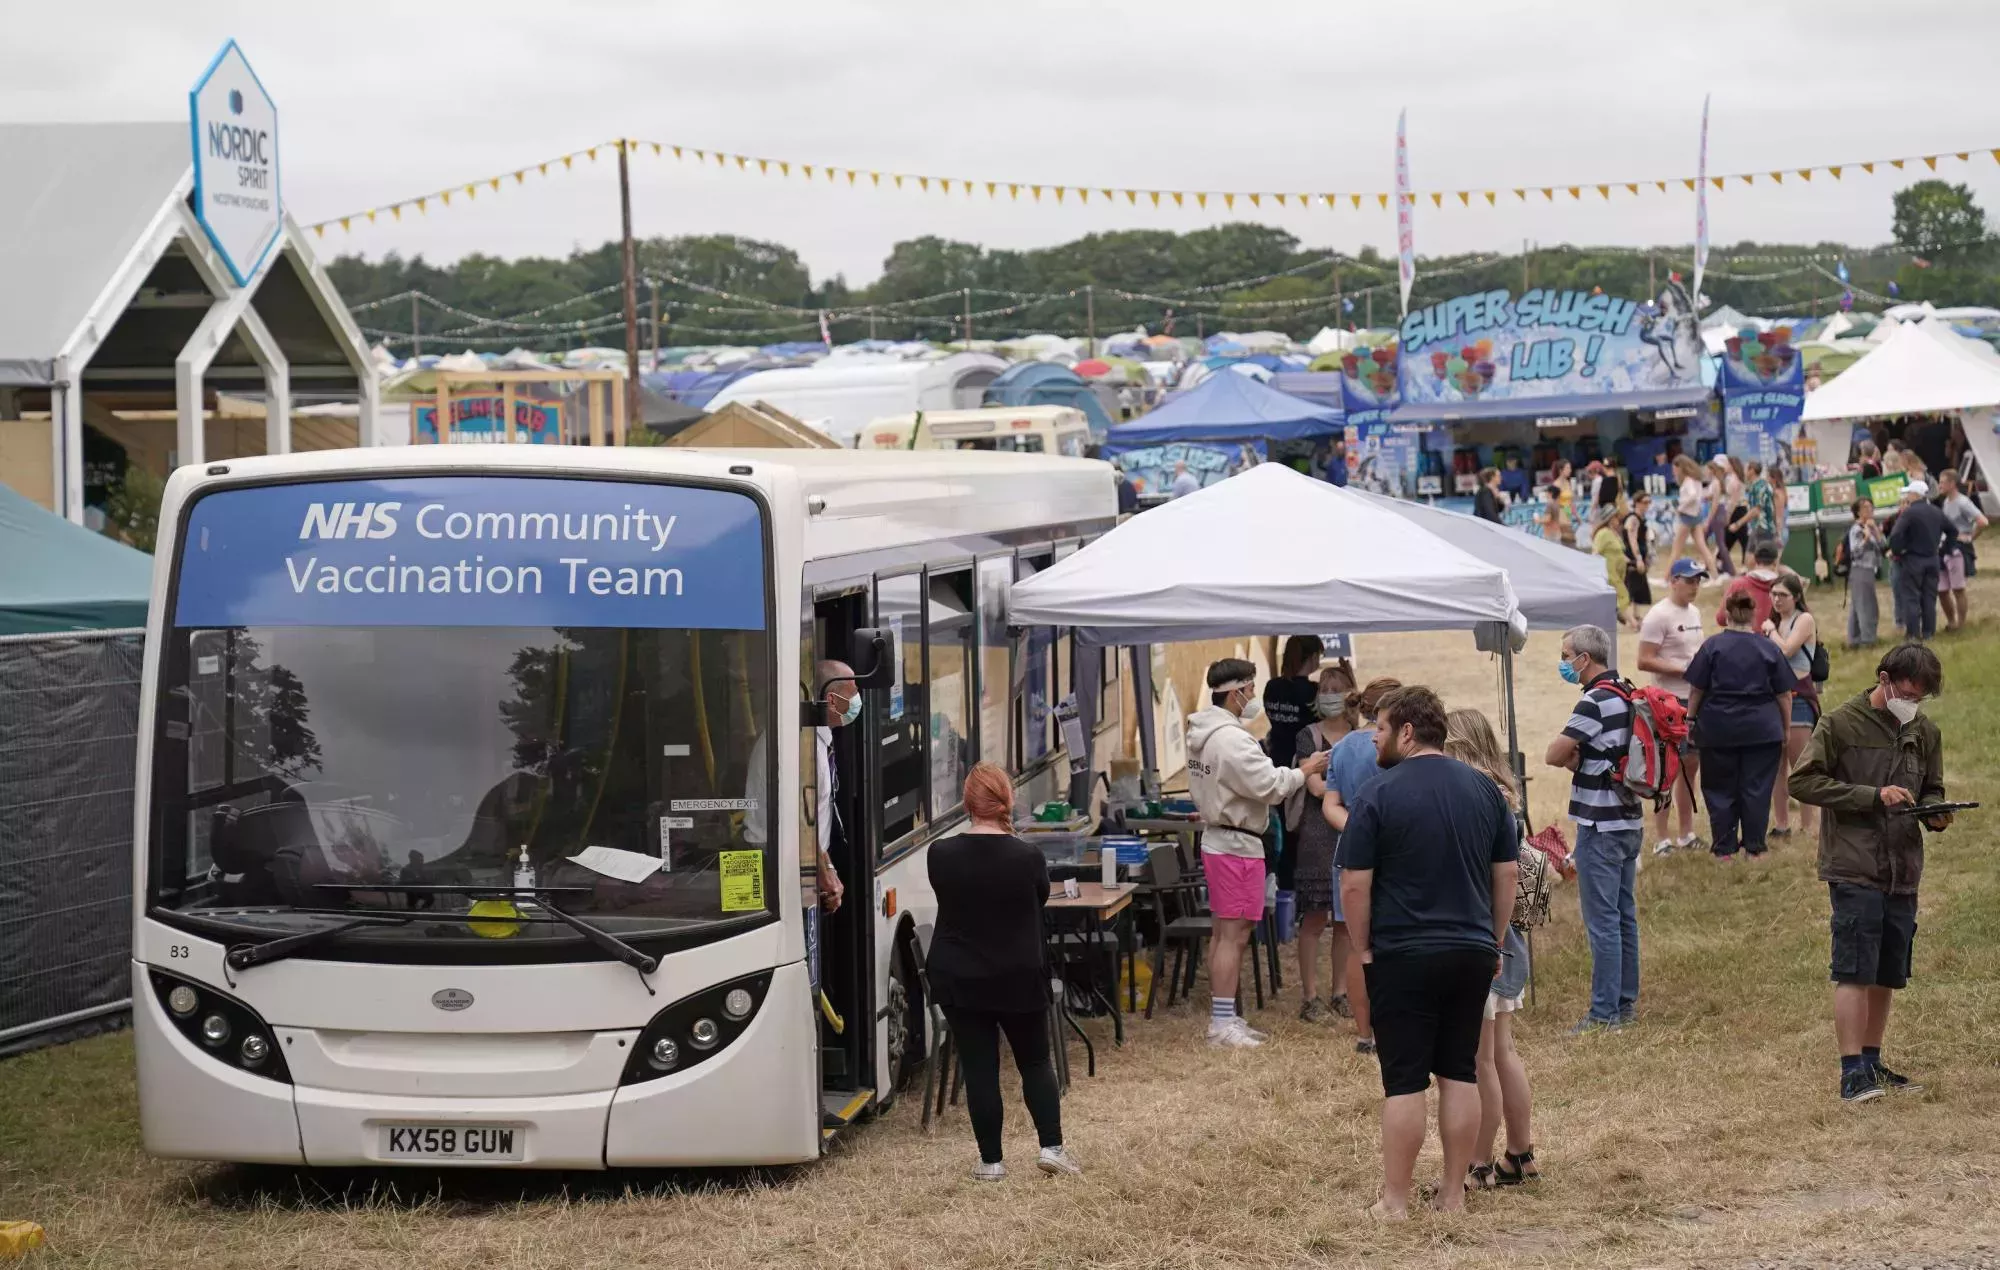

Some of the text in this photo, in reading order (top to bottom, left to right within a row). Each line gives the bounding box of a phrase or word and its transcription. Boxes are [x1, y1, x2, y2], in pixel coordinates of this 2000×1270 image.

[208, 119, 268, 166] NORDIC
[238, 165, 268, 190] SPIRIT
[1400, 286, 1637, 353] SUPER SLUSH
[1509, 337, 1576, 381] LAB
[299, 502, 677, 552] NHS Community
[285, 555, 683, 596] Vaccination Team
[672, 800, 758, 810] EMERGENCY EXIT
[171, 945, 188, 958] 83
[389, 1128, 513, 1154] KX58 GUW
